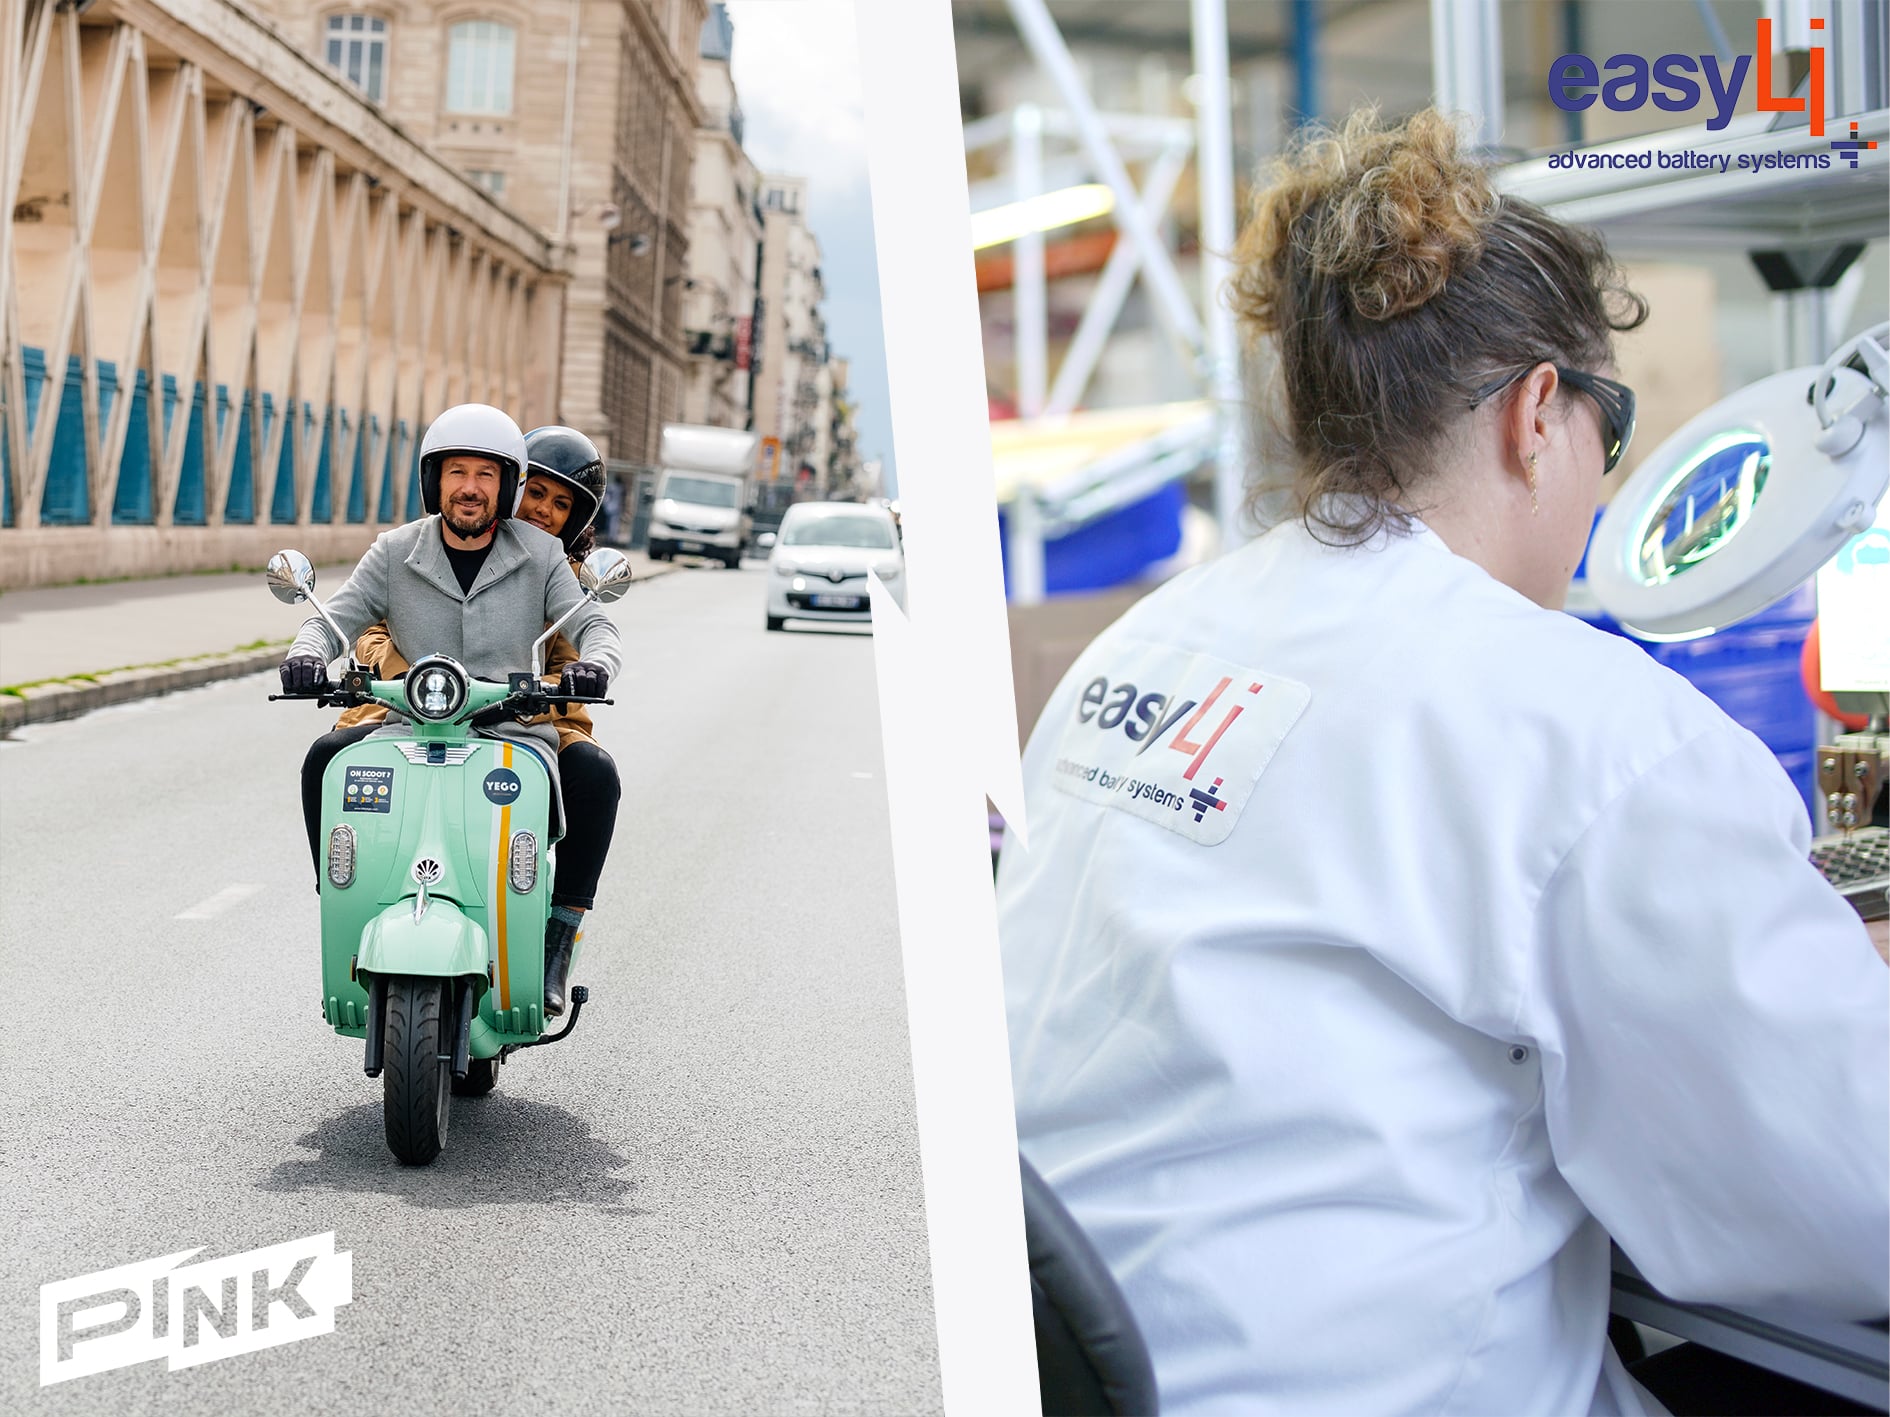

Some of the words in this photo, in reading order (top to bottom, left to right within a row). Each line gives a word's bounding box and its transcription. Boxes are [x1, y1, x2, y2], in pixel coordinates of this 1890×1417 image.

[362, 770, 386, 778] SCOOT
[486, 781, 519, 792] YEGO
[1127, 779, 1185, 812] systems
